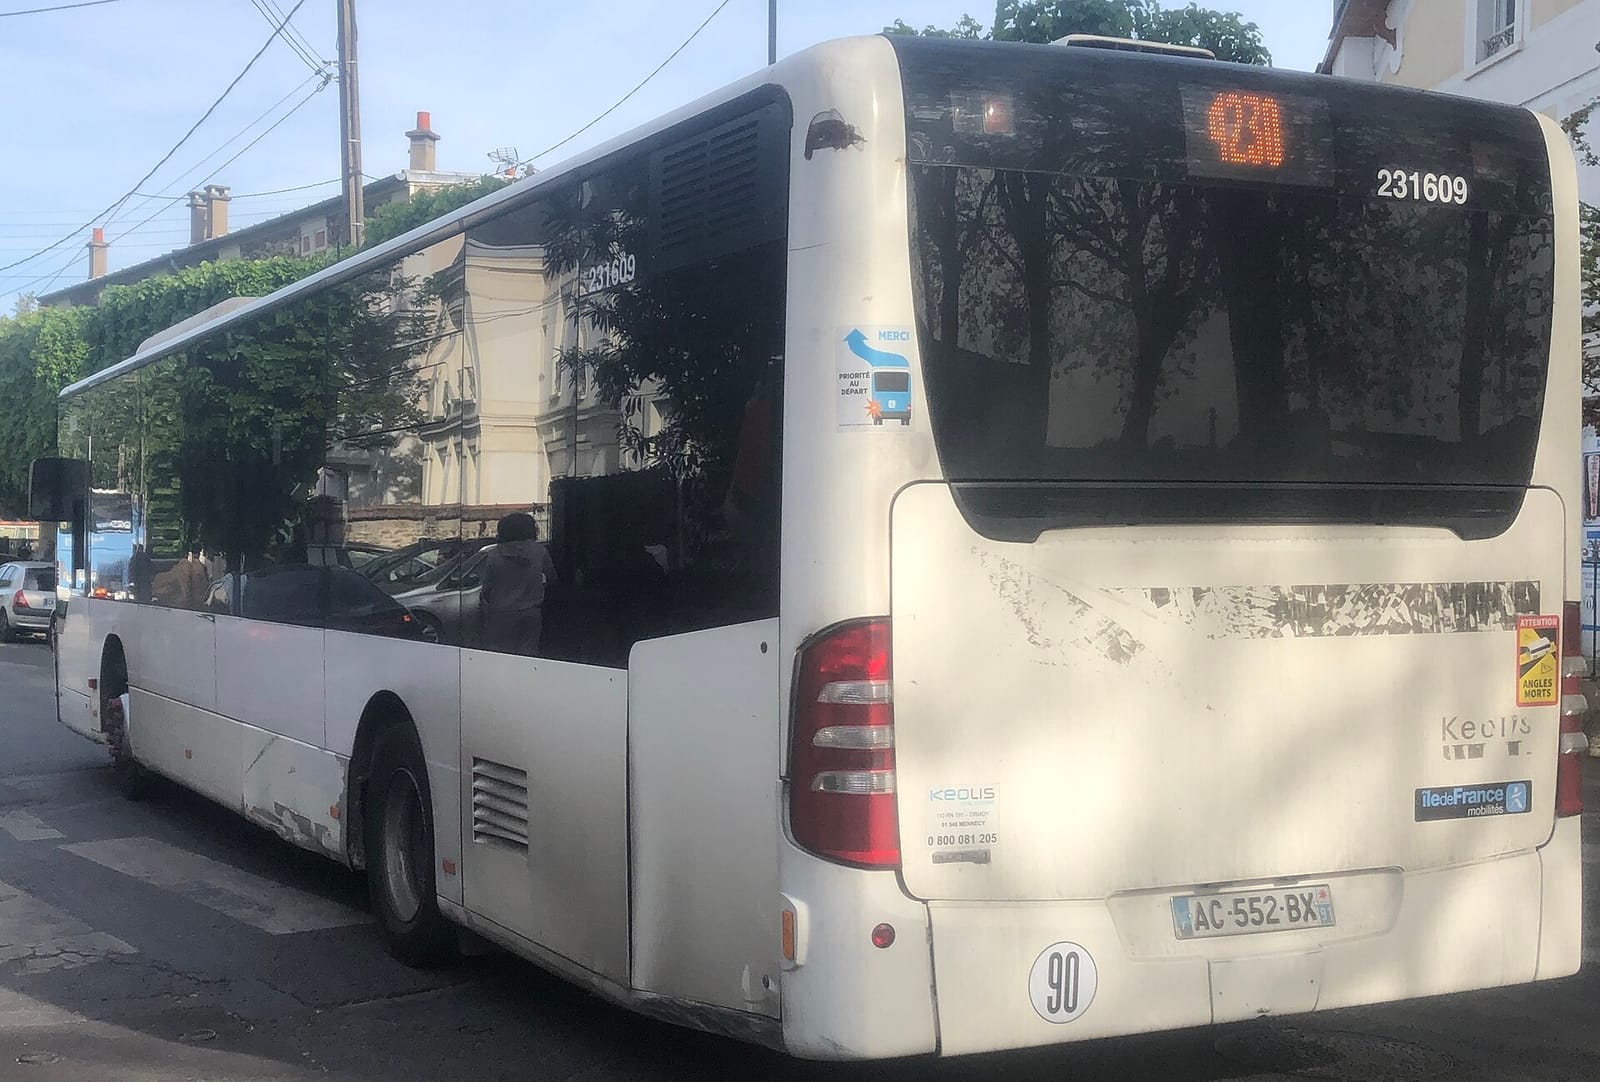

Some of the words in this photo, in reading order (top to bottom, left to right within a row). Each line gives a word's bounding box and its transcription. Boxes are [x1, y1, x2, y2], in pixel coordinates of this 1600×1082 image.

[1377, 168, 1468, 205] 231609
[588, 253, 636, 293] 231609
[878, 330, 910, 341] MERCI
[839, 371, 870, 380] PRIORITÉ
[1520, 617, 1558, 627] ATTENTION
[1523, 678, 1553, 688] ANGLES
[1524, 688, 1551, 698] MORTS
[1467, 804, 1504, 817] mobilités
[928, 836, 933, 846] 0
[937, 835, 955, 845] 800
[958, 834, 975, 845] 081
[979, 833, 997, 843] 205
[1047, 951, 1080, 1014] 90
